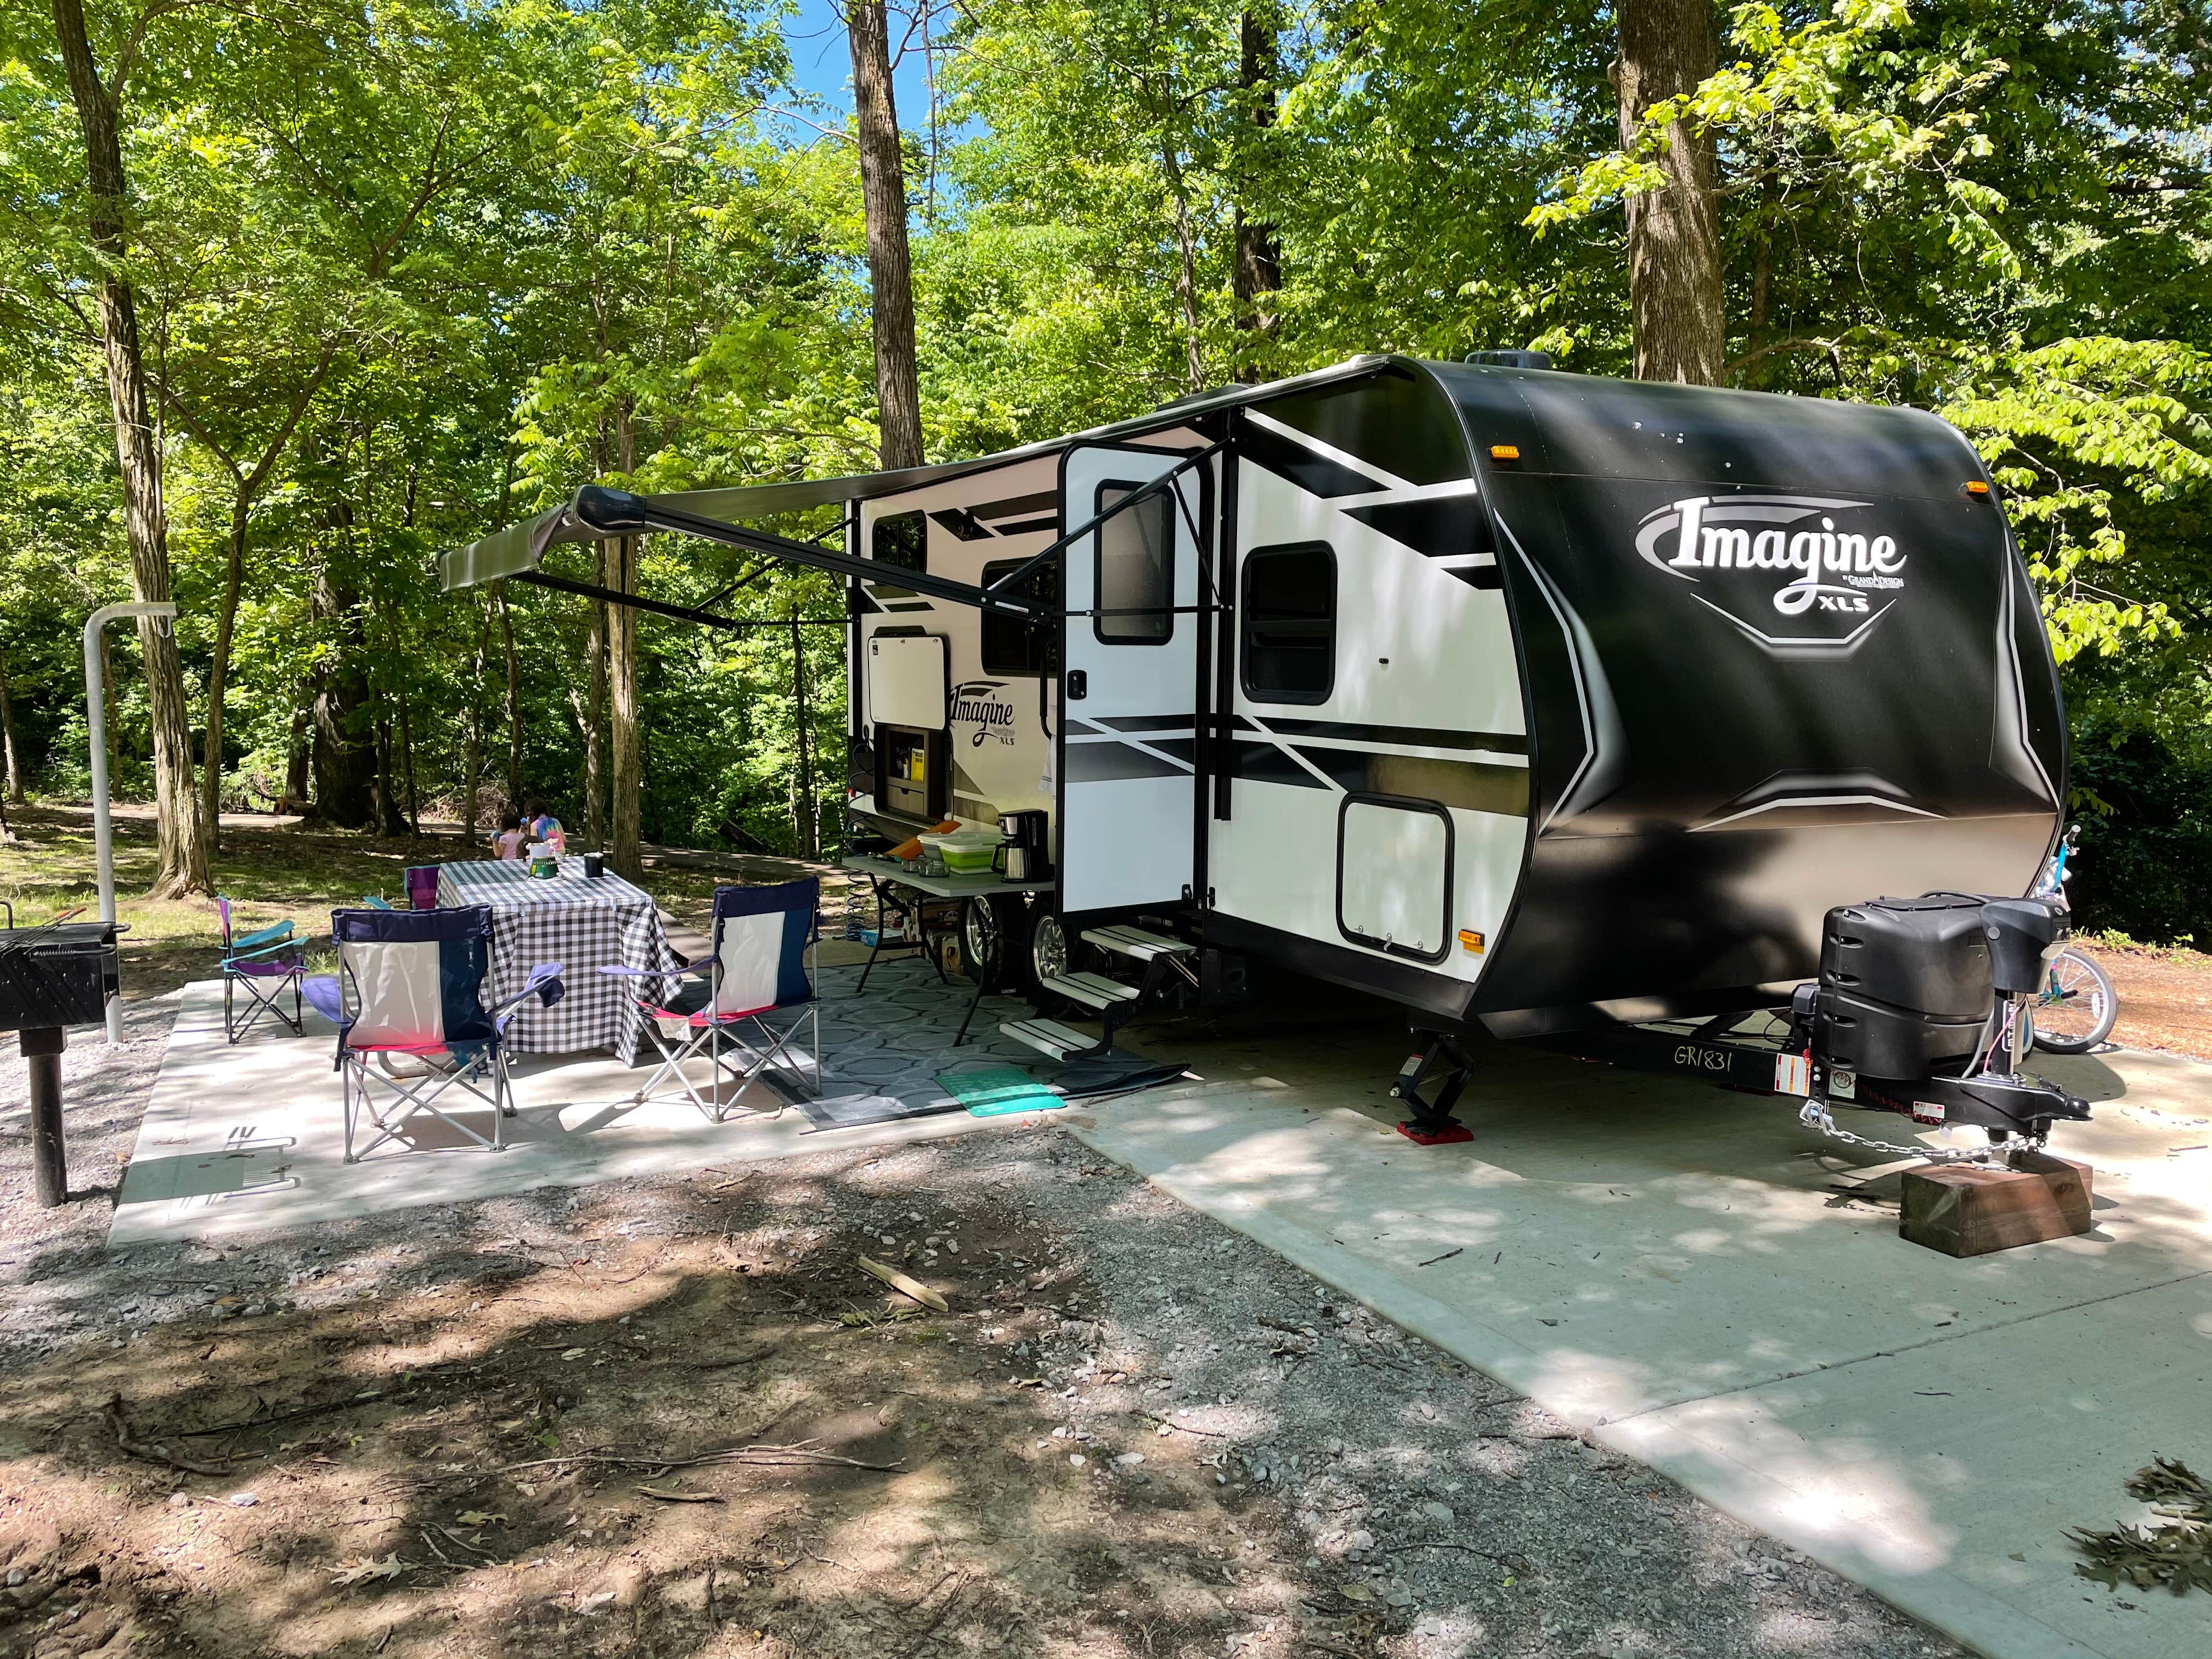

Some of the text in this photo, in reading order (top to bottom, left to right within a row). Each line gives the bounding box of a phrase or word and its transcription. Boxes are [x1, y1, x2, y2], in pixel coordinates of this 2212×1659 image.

[1668, 496, 1906, 614] Imagine
[1818, 596, 1869, 612] XLS
[950, 684, 1015, 747] Imagine
[1000, 737, 1014, 746] XLS
